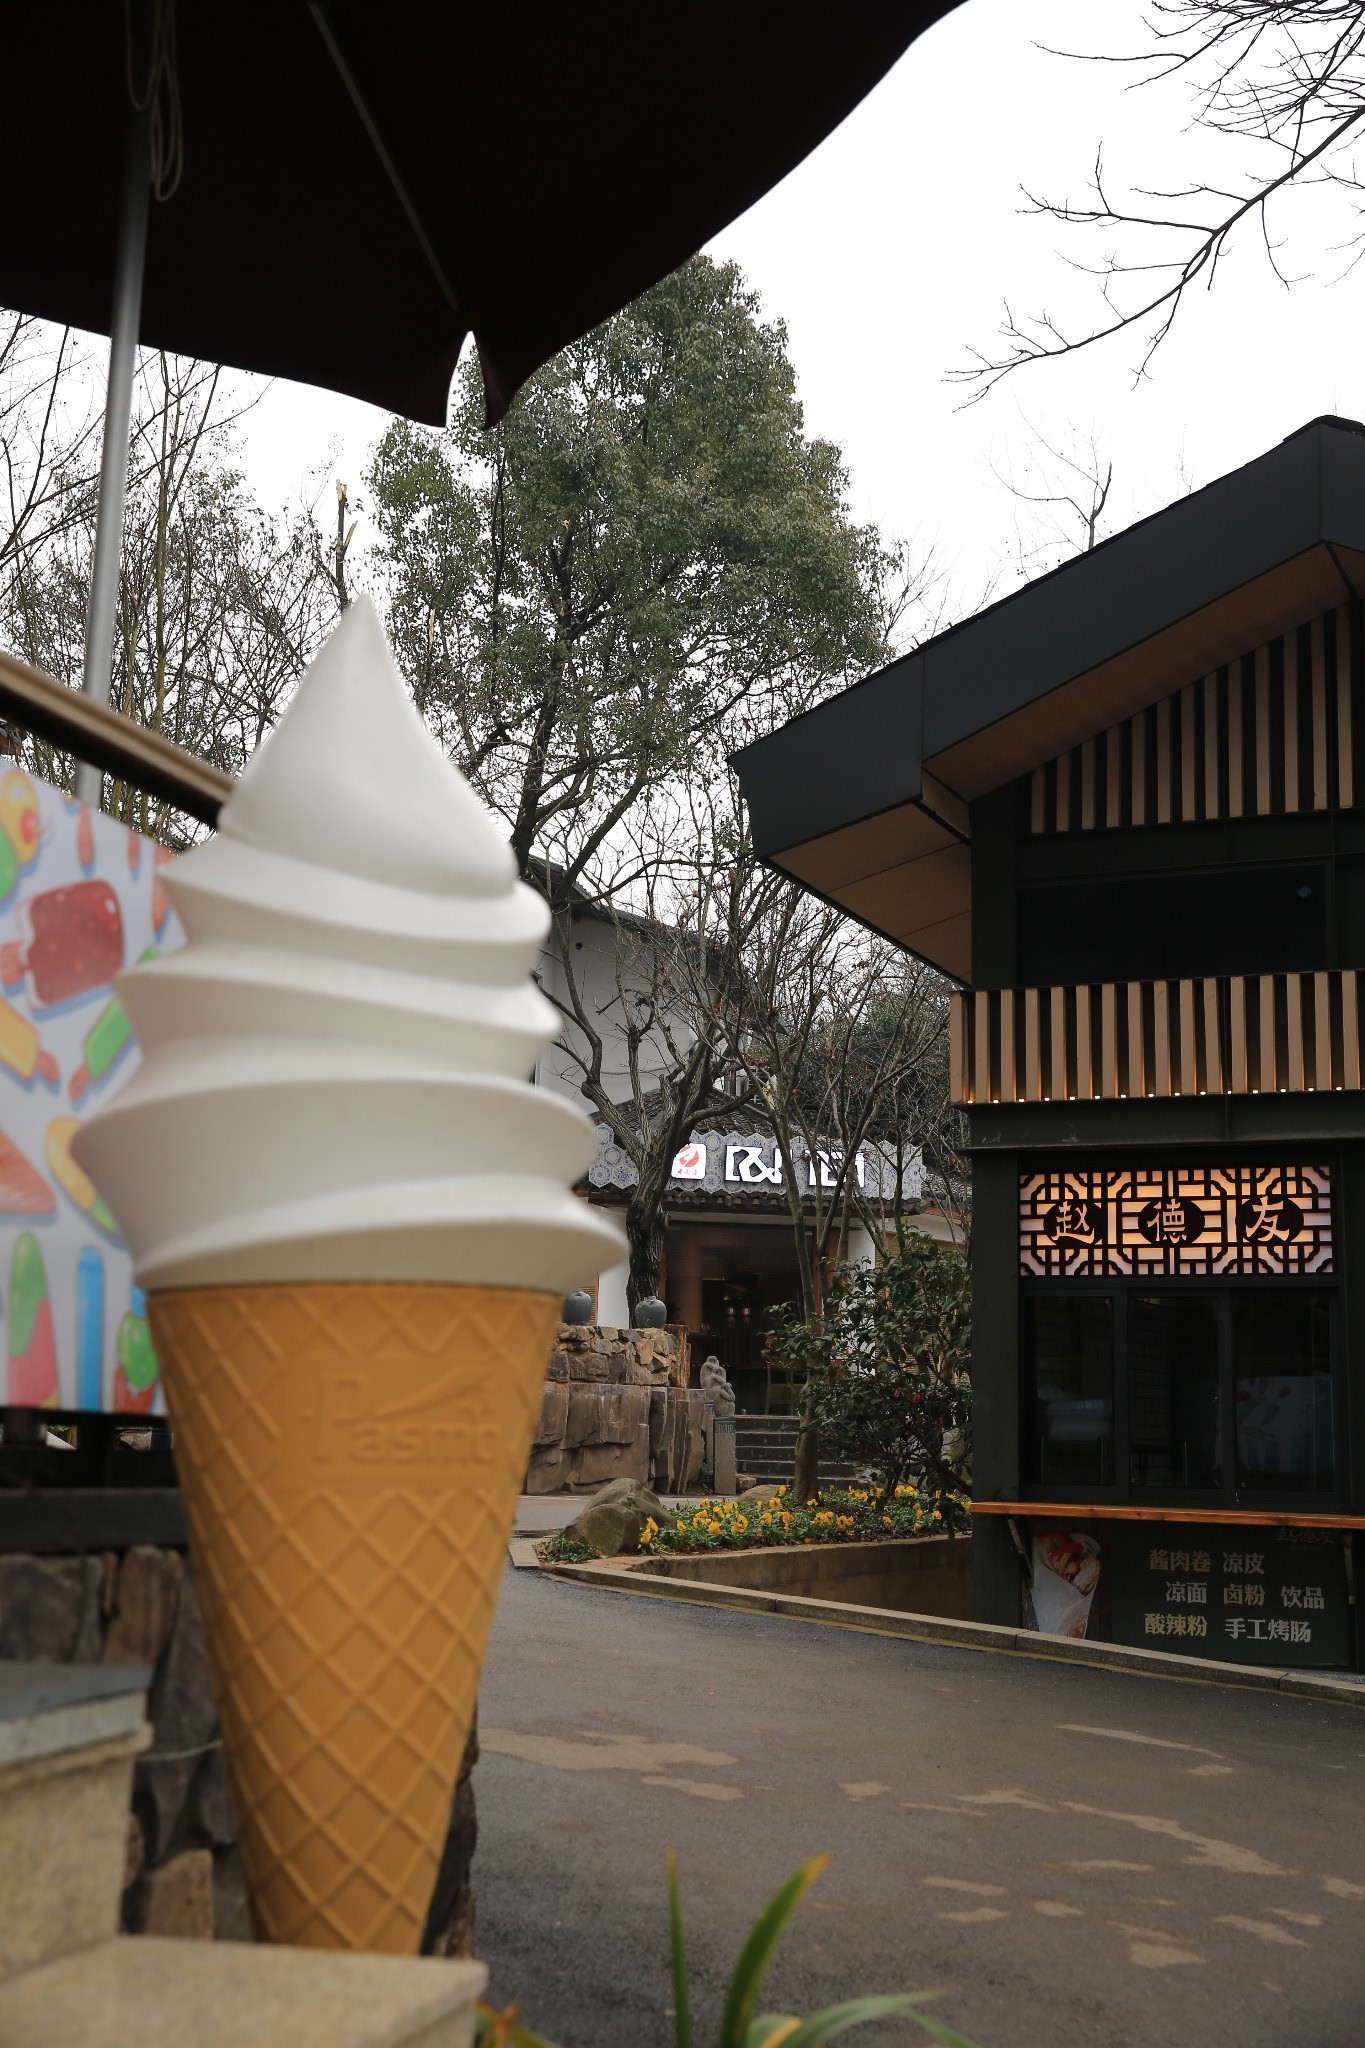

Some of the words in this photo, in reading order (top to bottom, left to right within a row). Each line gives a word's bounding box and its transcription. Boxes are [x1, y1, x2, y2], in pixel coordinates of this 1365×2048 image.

[1051, 1195, 1290, 1245] 赵德友
[1148, 1548, 1212, 1574] 酱肉卷
[1222, 1551, 1265, 1575] 凉皮
[1165, 1580, 1208, 1604] 凉面
[1223, 1583, 1266, 1606] 卤粉
[1280, 1585, 1325, 1610] 饮品
[1144, 1612, 1208, 1638] 酸辣粉
[1224, 1617, 1312, 1644] 手工烤肠
